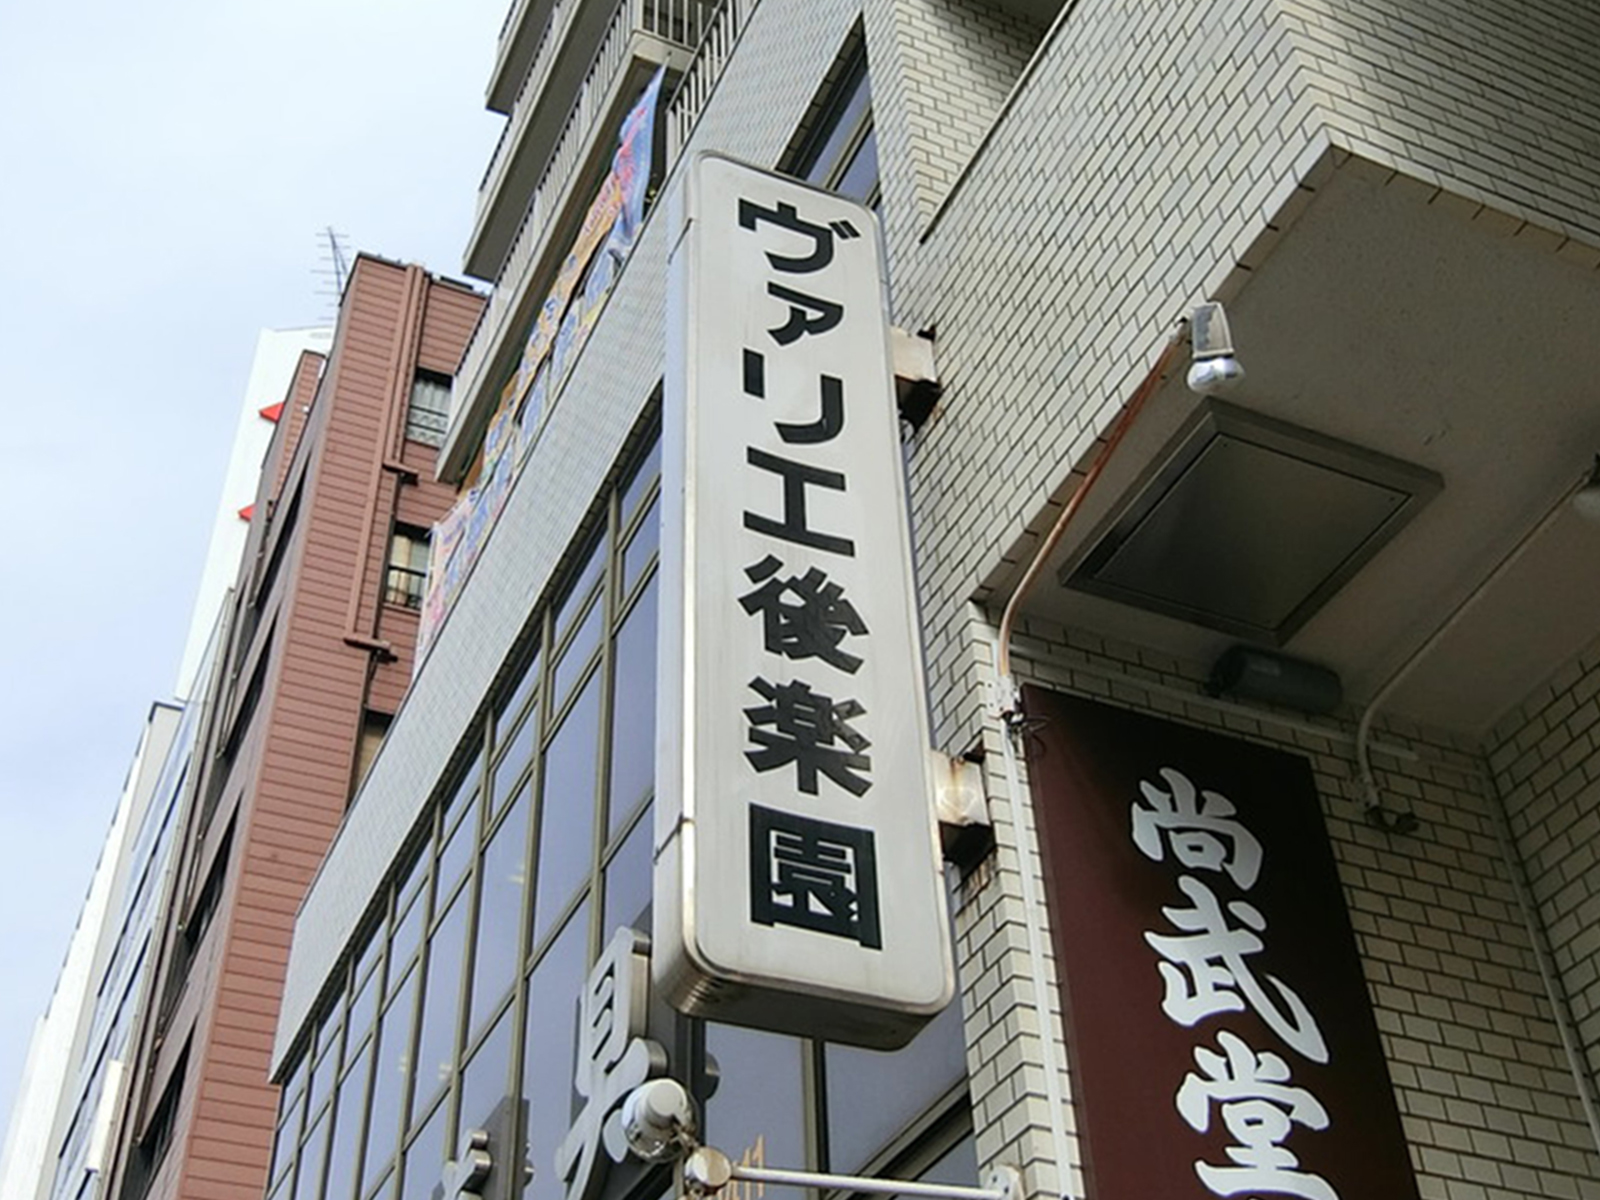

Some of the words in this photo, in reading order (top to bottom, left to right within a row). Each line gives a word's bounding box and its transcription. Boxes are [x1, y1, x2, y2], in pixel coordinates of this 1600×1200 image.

[738, 198, 883, 951] ヴァリエ後楽園
[1131, 767, 1340, 1200] 尚武堂
